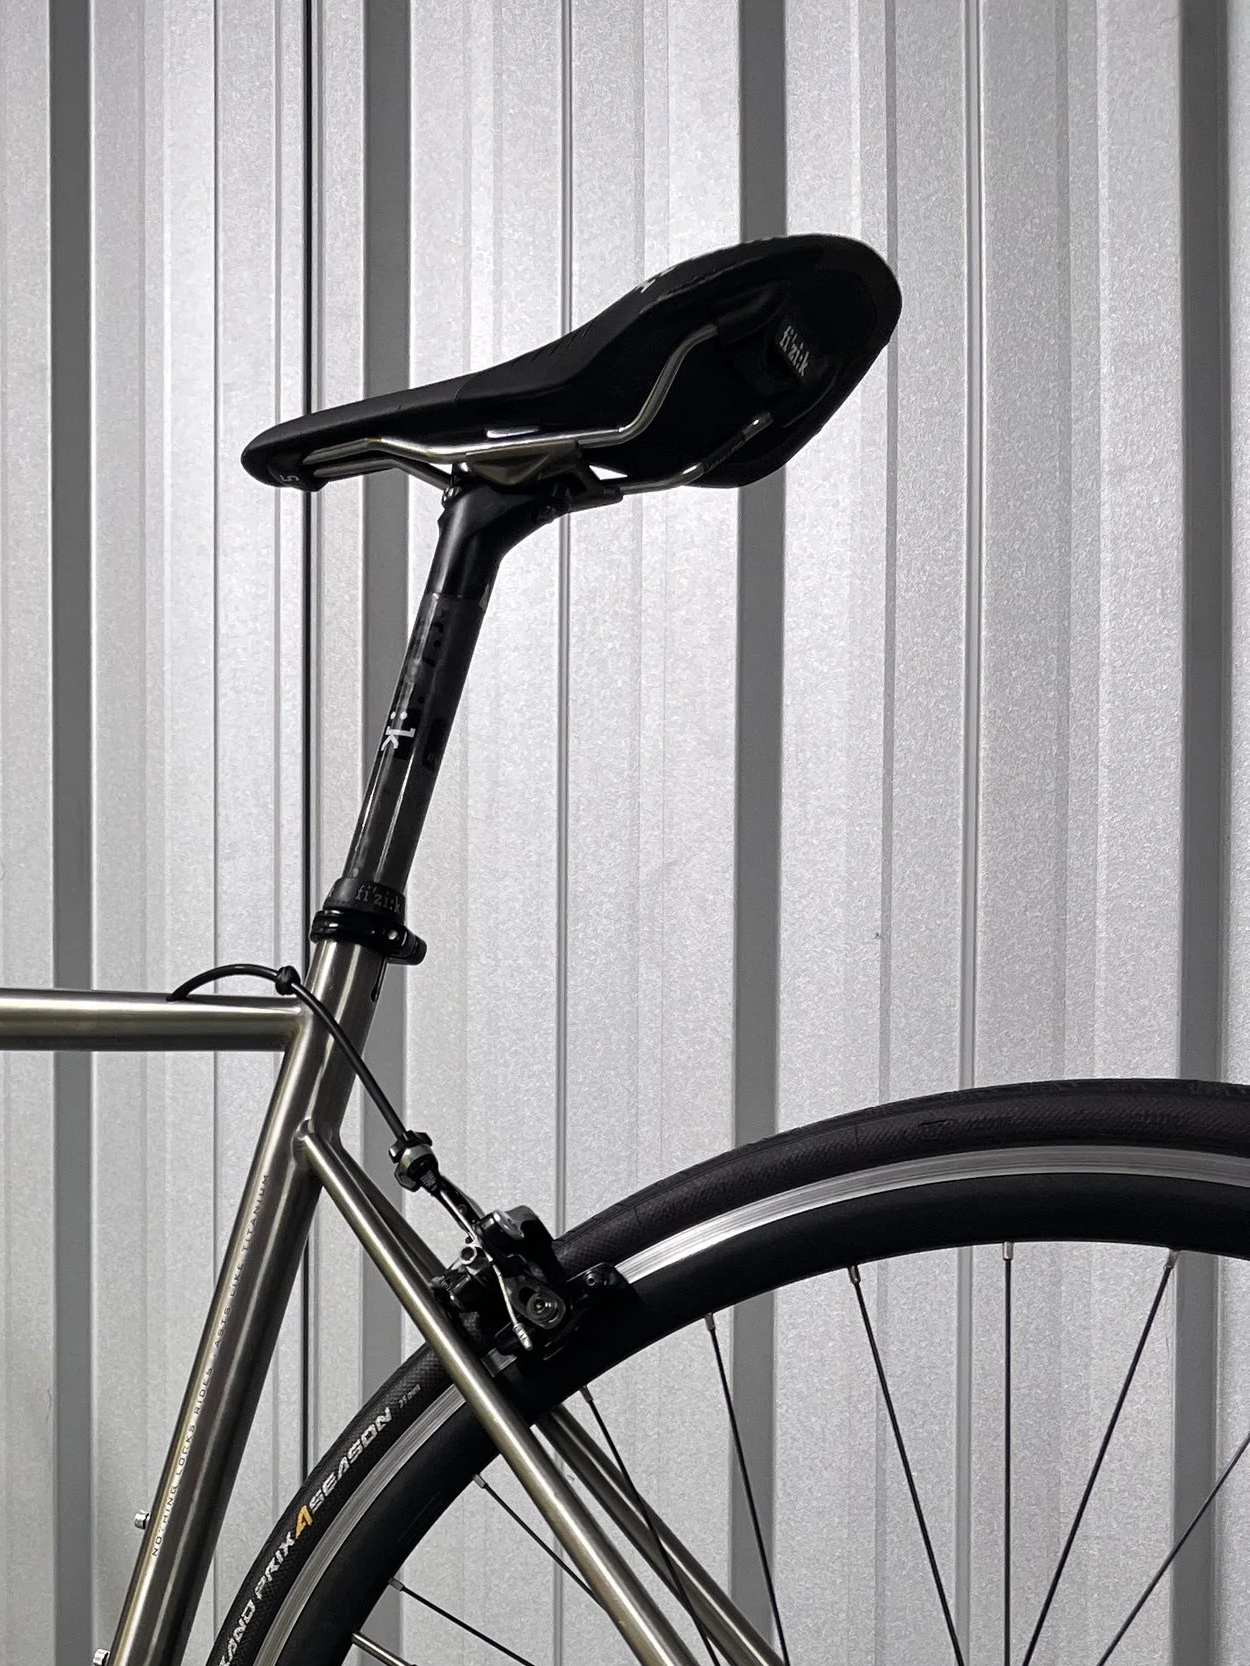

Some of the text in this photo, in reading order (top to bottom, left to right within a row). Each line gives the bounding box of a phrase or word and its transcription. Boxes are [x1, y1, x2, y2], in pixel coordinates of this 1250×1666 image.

[241, 1174, 269, 1253] TITANIUM
[254, 1530, 296, 1600] PRIX
[308, 1405, 392, 1514] SEASON
